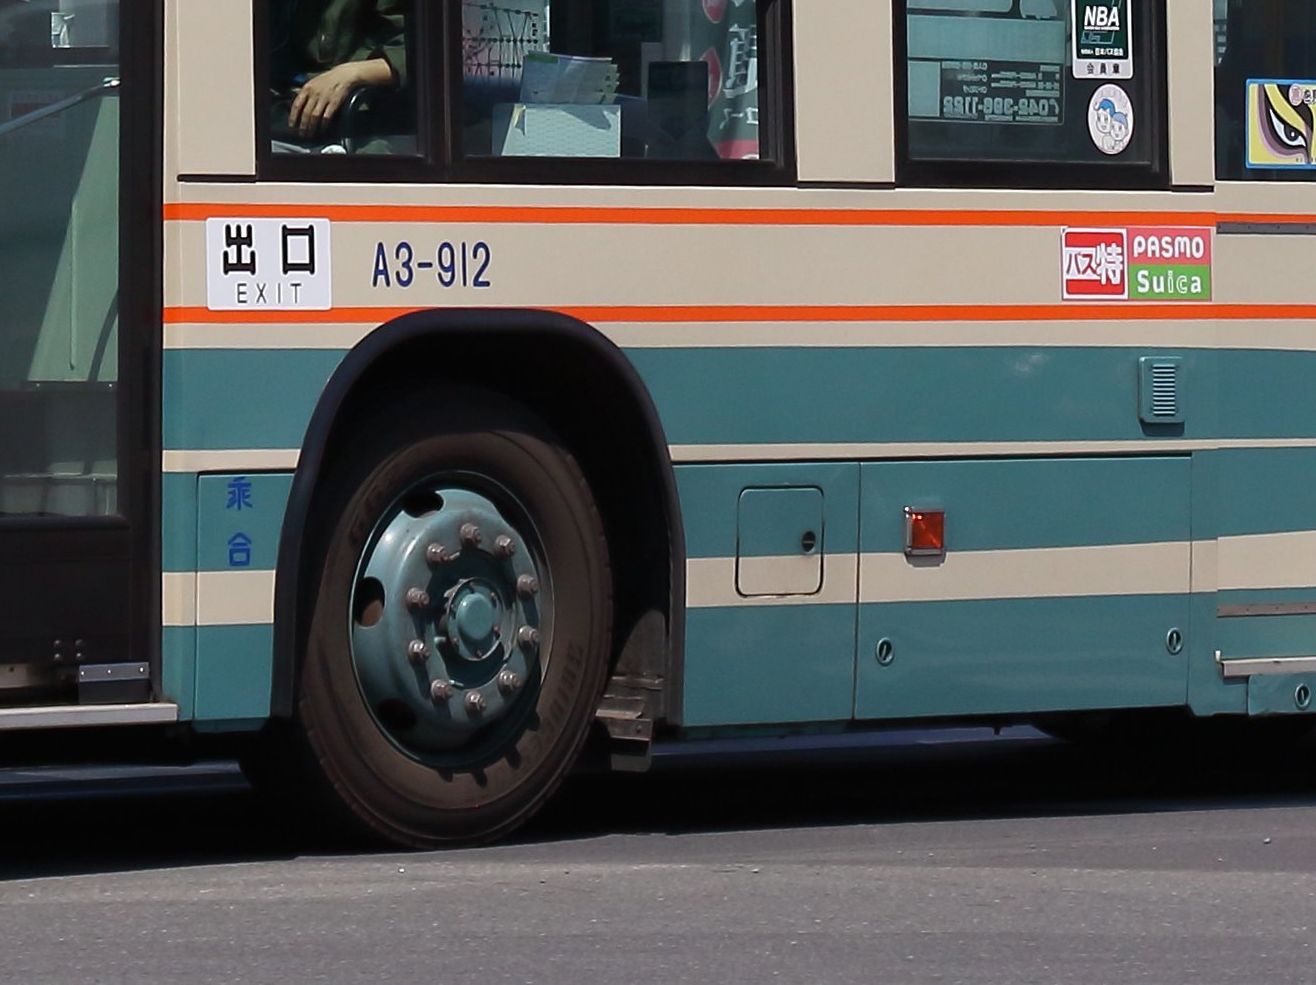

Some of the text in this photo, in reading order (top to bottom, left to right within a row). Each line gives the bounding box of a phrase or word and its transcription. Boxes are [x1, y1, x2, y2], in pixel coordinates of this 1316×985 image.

[1084, 5, 1120, 26] NBA
[222, 224, 316, 276] 出口
[1132, 235, 1204, 259] PASMO
[372, 241, 492, 288] A3-912
[1066, 242, 1124, 286] バス特
[236, 282, 302, 304] EXIT
[1137, 269, 1202, 294] Suica
